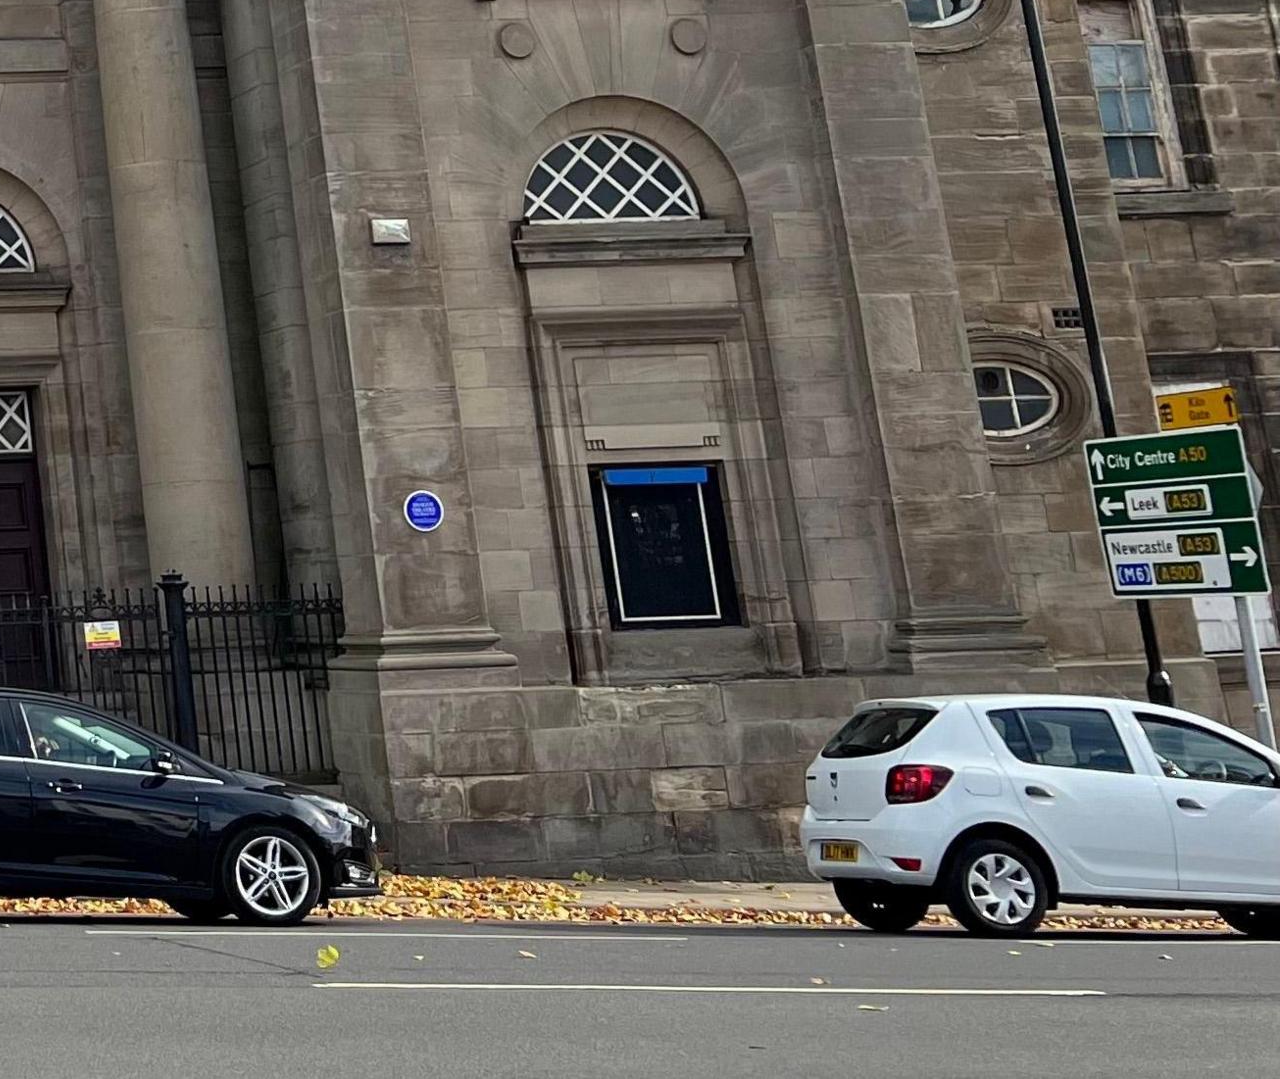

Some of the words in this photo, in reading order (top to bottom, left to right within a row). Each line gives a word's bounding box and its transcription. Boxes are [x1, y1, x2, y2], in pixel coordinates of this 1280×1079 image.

[1106, 454, 1131, 471] City
[1134, 450, 1176, 467] Centre
[1179, 446, 1207, 463] A50
[1130, 496, 1160, 512] Leek
[1166, 492, 1206, 511] (A53)
[1110, 539, 1174, 556] Newcastle
[1179, 535, 1220, 555] (A53)
[1118, 565, 1152, 584] (M6)
[1155, 564, 1203, 583] (A500)
